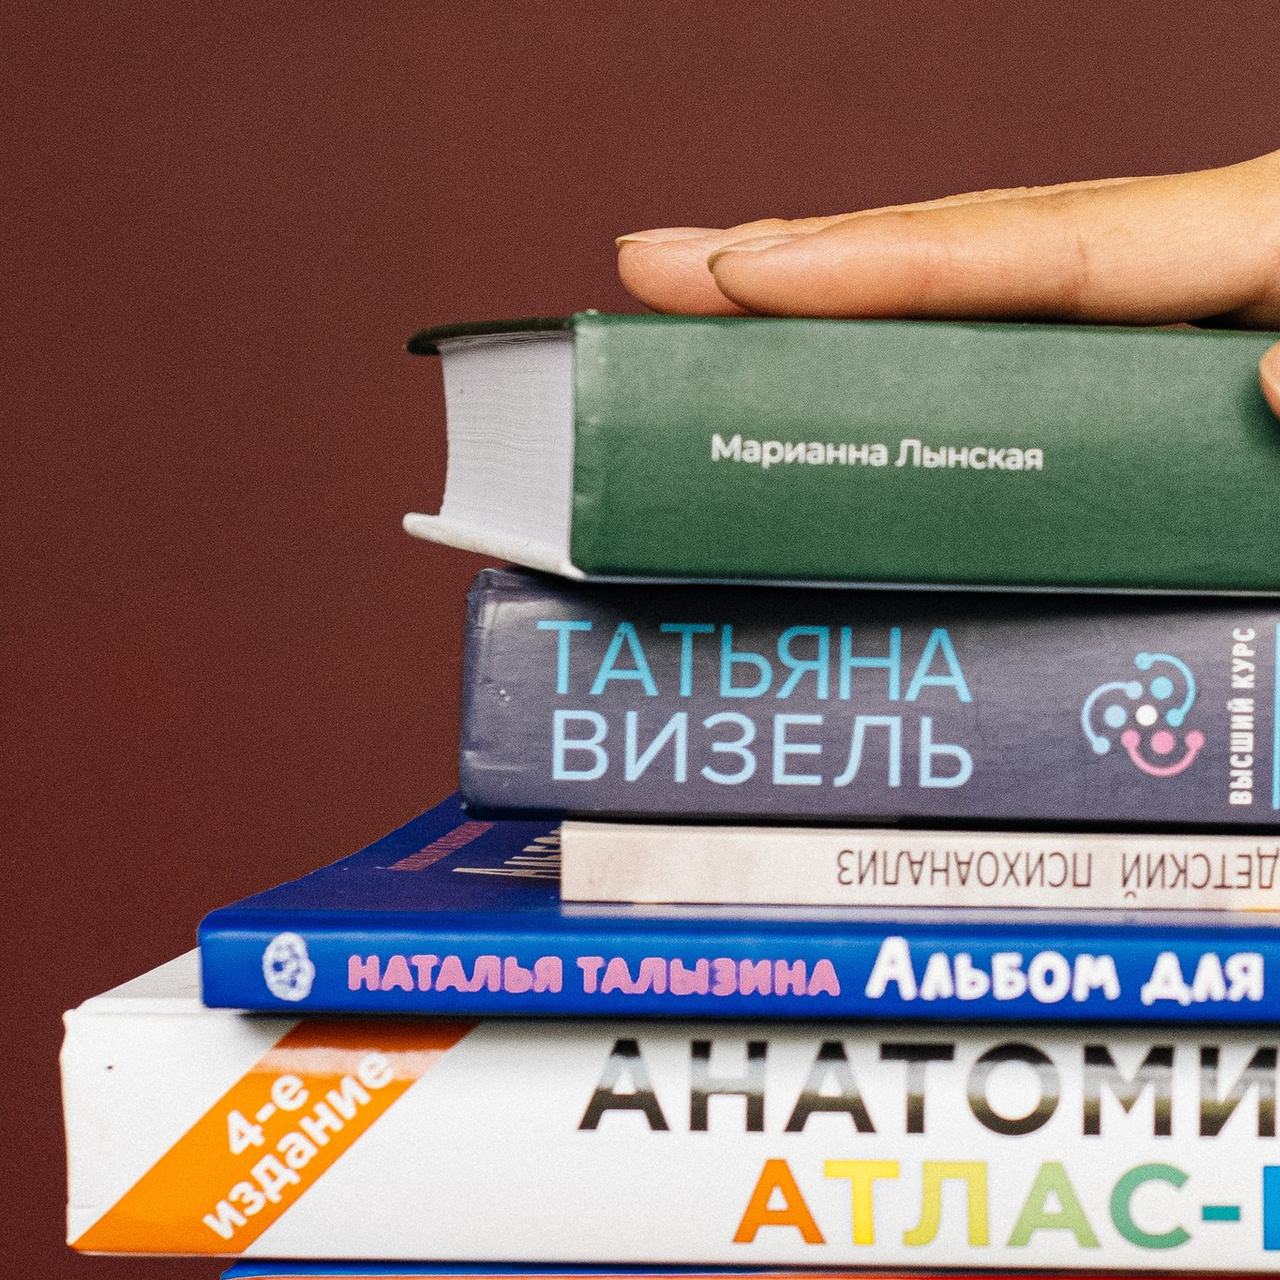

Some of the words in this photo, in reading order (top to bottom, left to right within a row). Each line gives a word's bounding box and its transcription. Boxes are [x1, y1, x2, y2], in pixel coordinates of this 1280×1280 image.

[711, 434, 888, 468] Марианна
[895, 440, 1045, 472] Лынская
[536, 620, 972, 704] ТАТЬЯНА
[1231, 627, 1256, 689] КУРС
[551, 710, 975, 788] ВИЗЕЛЬ
[1226, 697, 1255, 805] ВЫСШИЙ
[835, 849, 1093, 888] ПСИХОАНАЛИЗ
[1120, 847, 1279, 899] ДЕТСКИЙ
[347, 954, 563, 993] НАТАЛЬЯ
[576, 956, 841, 997] ТАЛЫЗИНА
[202, 1051, 396, 1240] издание
[225, 1072, 311, 1155] 4-е
